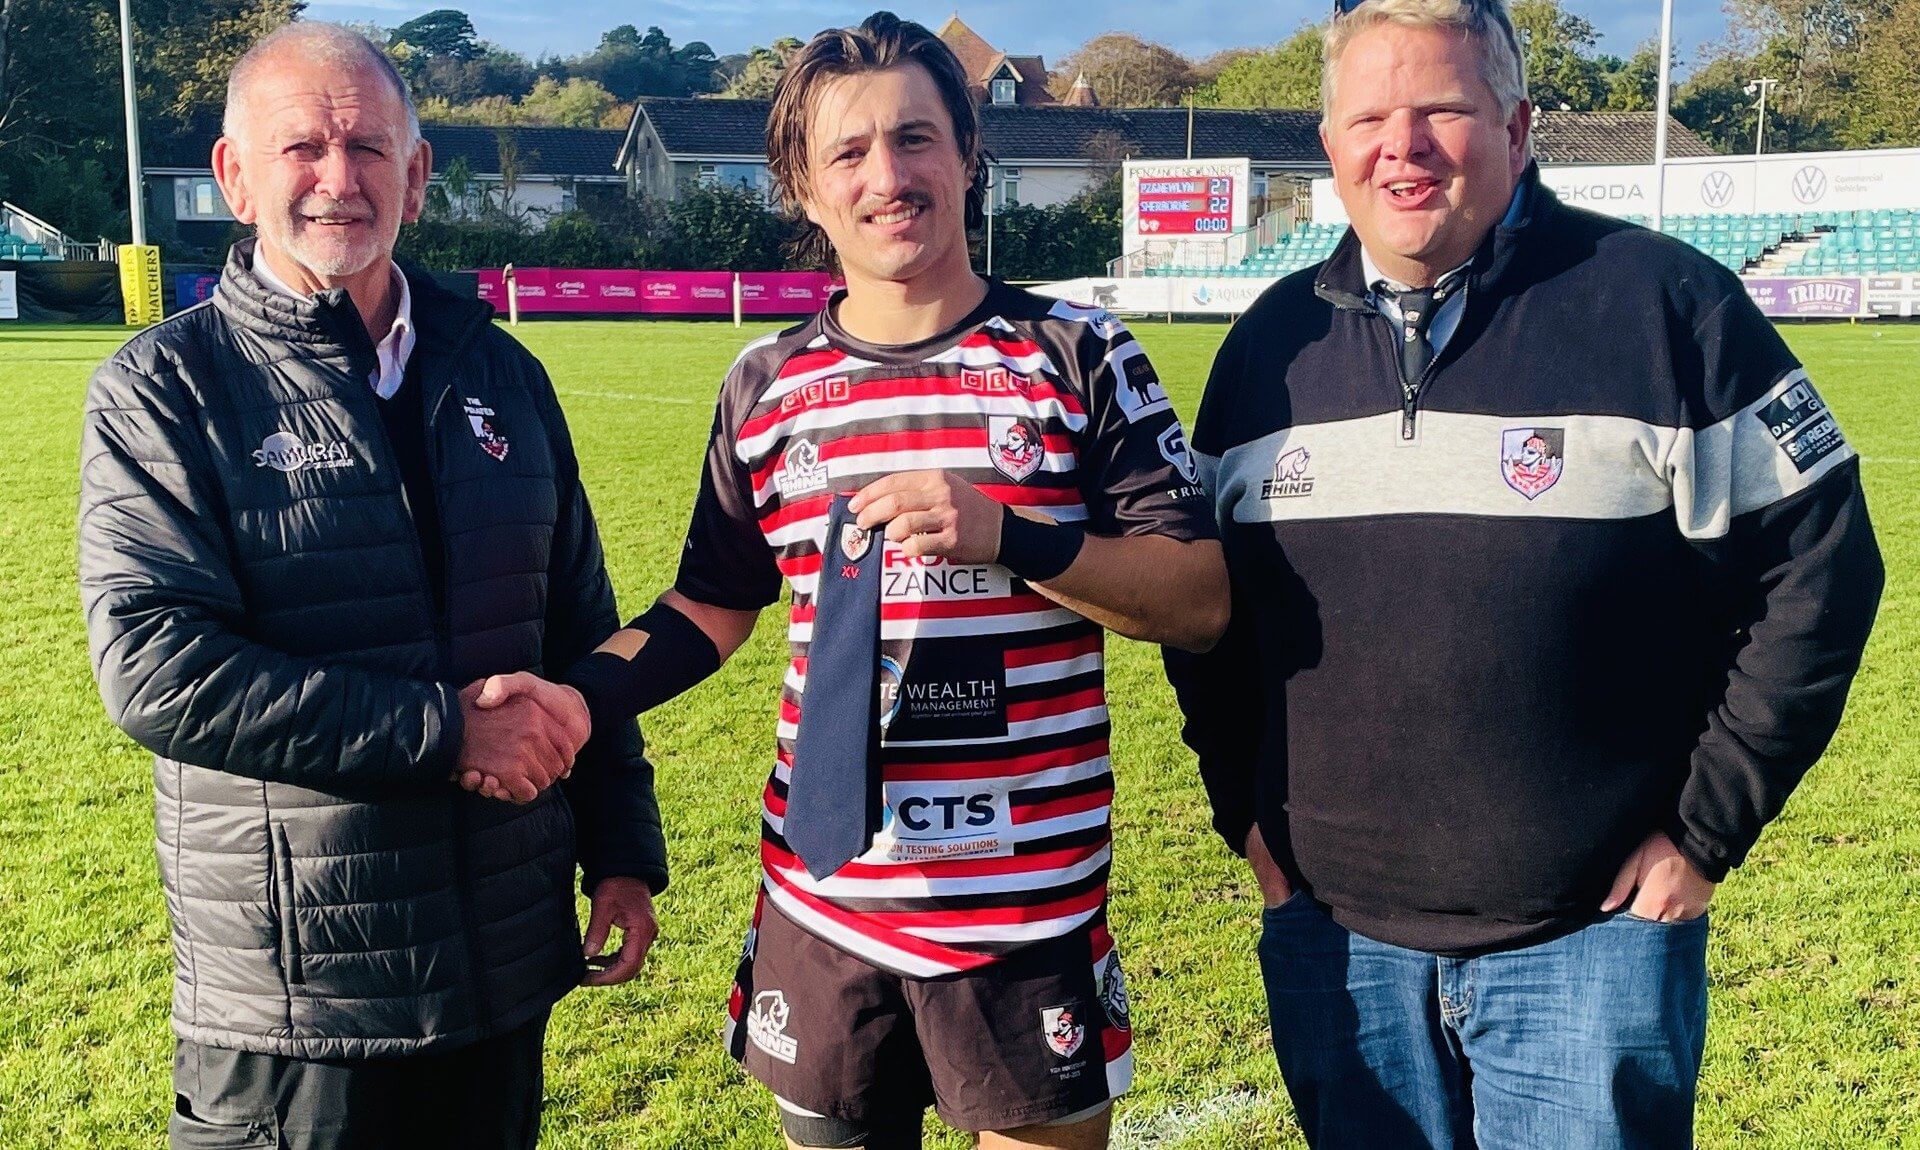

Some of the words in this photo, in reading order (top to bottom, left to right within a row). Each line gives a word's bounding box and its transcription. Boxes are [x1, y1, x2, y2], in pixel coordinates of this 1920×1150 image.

[1210, 179, 1230, 195] 27
[1210, 198, 1230, 213] 22
[1195, 218, 1228, 231] 00:00
[145, 249, 160, 324] THATCHERS
[1788, 283, 1856, 306] TRIBUTE
[252, 440, 349, 468] SAMURAI
[1261, 482, 1314, 498] RHINO
[841, 564, 861, 579] XV
[885, 568, 990, 596] ZANCE
[907, 679, 996, 700] WEALTH
[911, 698, 996, 712] MANAGEMENT
[899, 793, 996, 832] CTS
[906, 844, 944, 855] TESTING
[947, 839, 999, 853] SOLUTIONS
